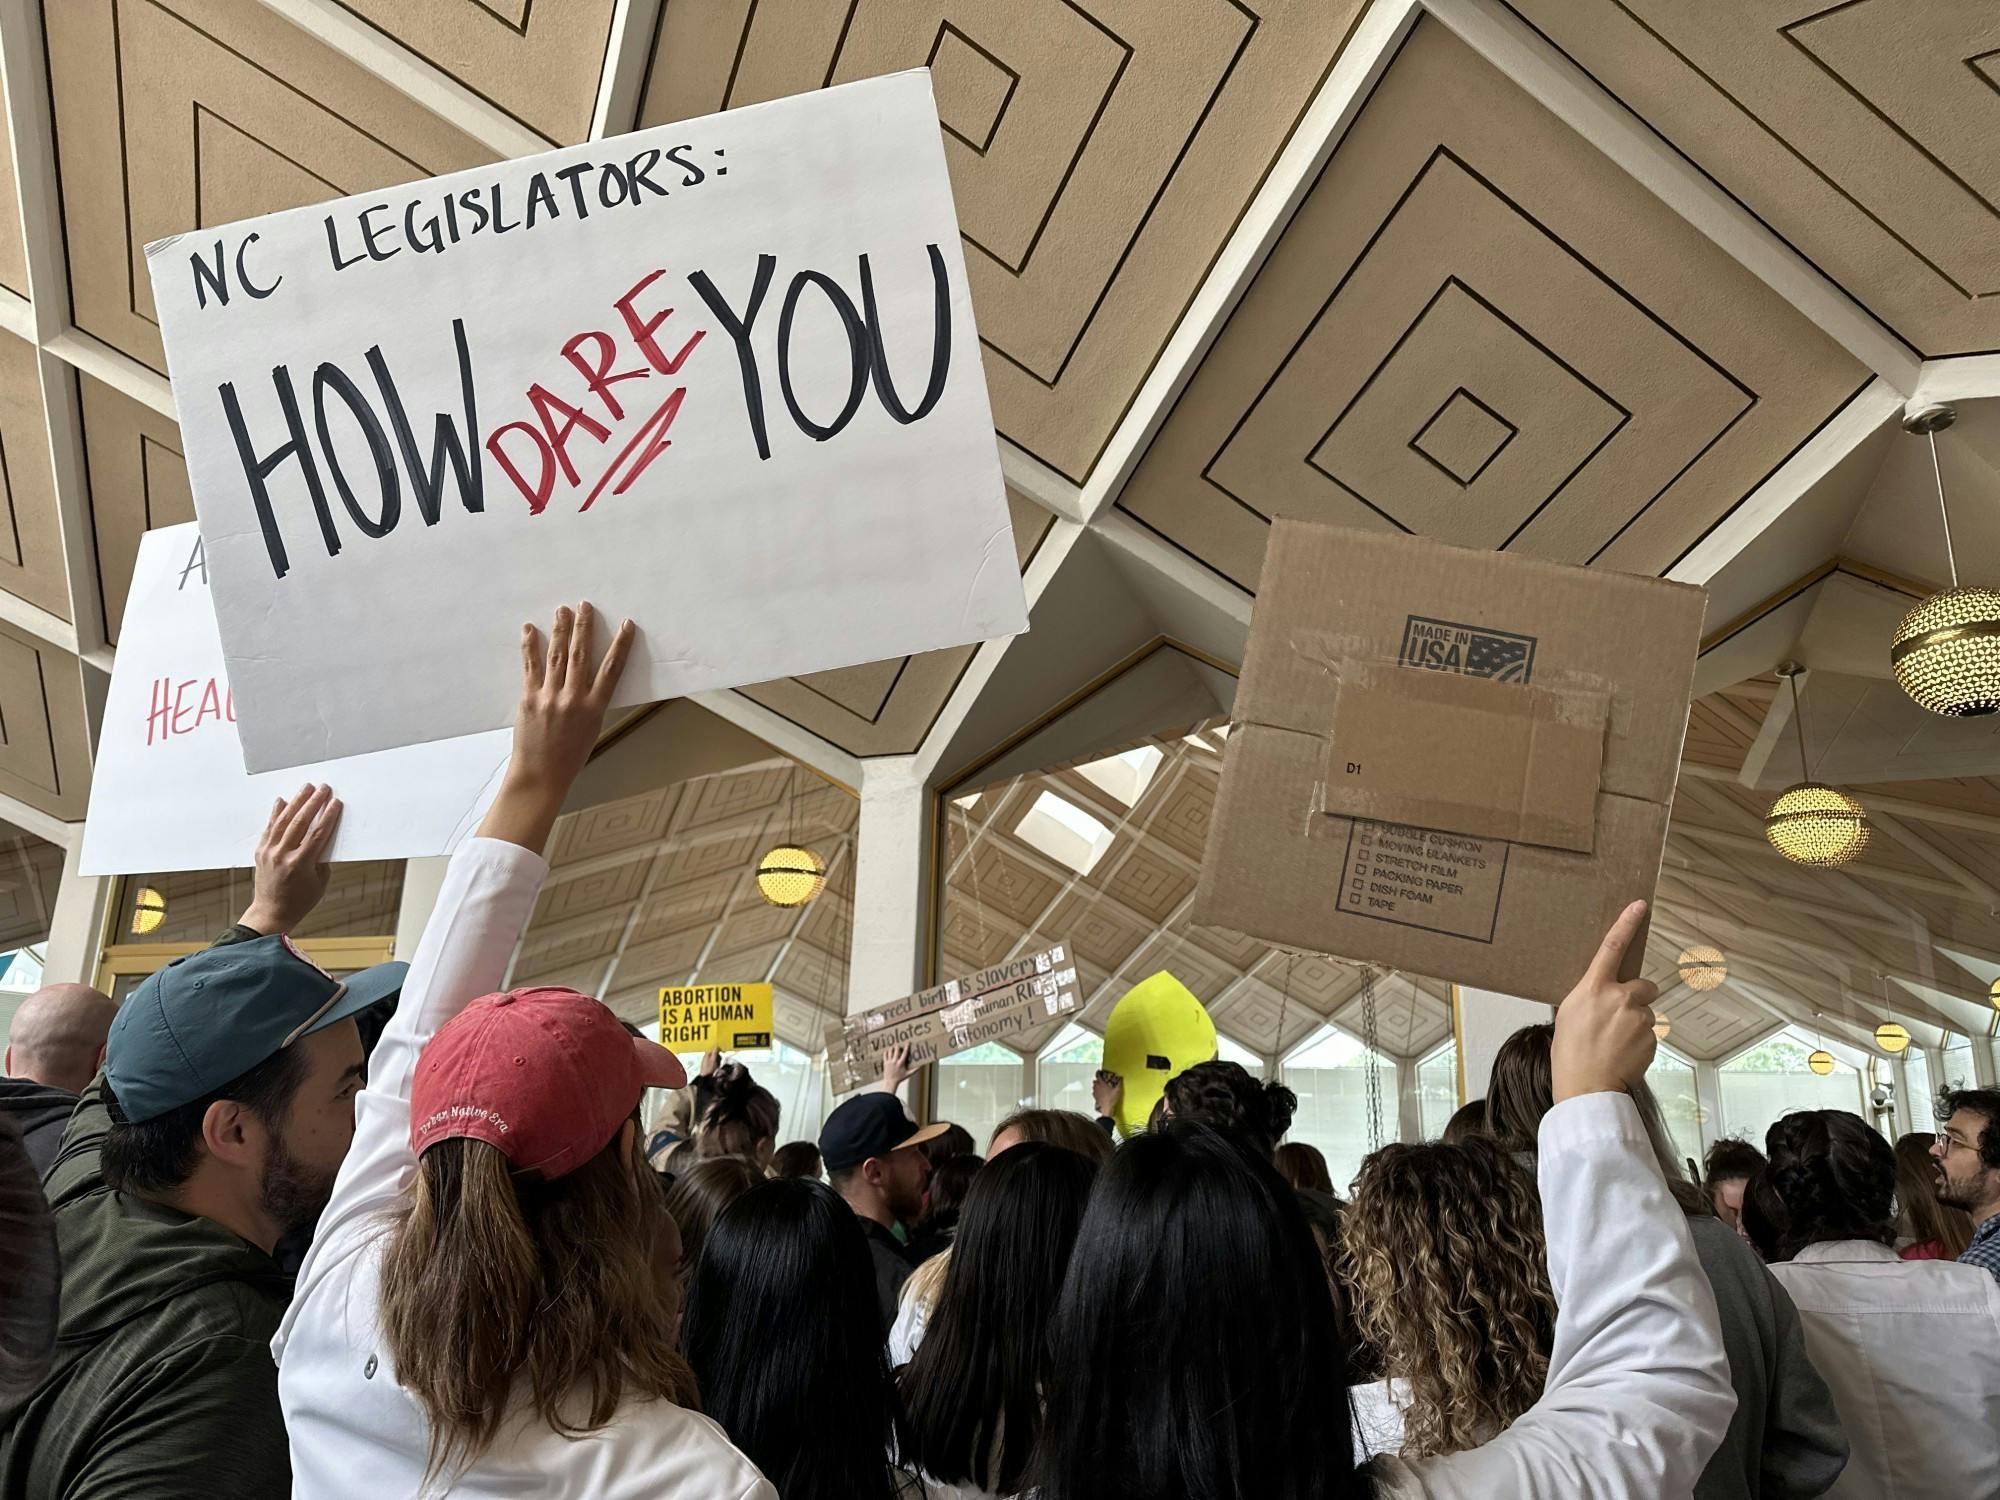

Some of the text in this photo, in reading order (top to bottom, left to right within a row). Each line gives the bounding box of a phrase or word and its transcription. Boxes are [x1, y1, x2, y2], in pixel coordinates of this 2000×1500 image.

[189, 144, 729, 311] NC LEGISLATORS:
[219, 244, 952, 580] HOW DARE YOU
[1413, 623, 1469, 645] MADE IN
[1408, 636, 1460, 673] USA
[1346, 762, 1362, 774] D1
[1375, 852, 1459, 879] STRETCH FILM
[1378, 837, 1487, 869] MOVING BLANKETS
[1370, 882, 1433, 904] DISH FOAM
[1372, 867, 1464, 896] PACKING PAPER
[1367, 896, 1396, 912] TAPE
[662, 986, 742, 1007] ABORTION
[663, 1004, 754, 1025] IS A HUMAN
[662, 1024, 710, 1043] RIGHT
[871, 1021, 932, 1051] violates
[451, 1105, 488, 1118] Native
[489, 1113, 510, 1135] Era
